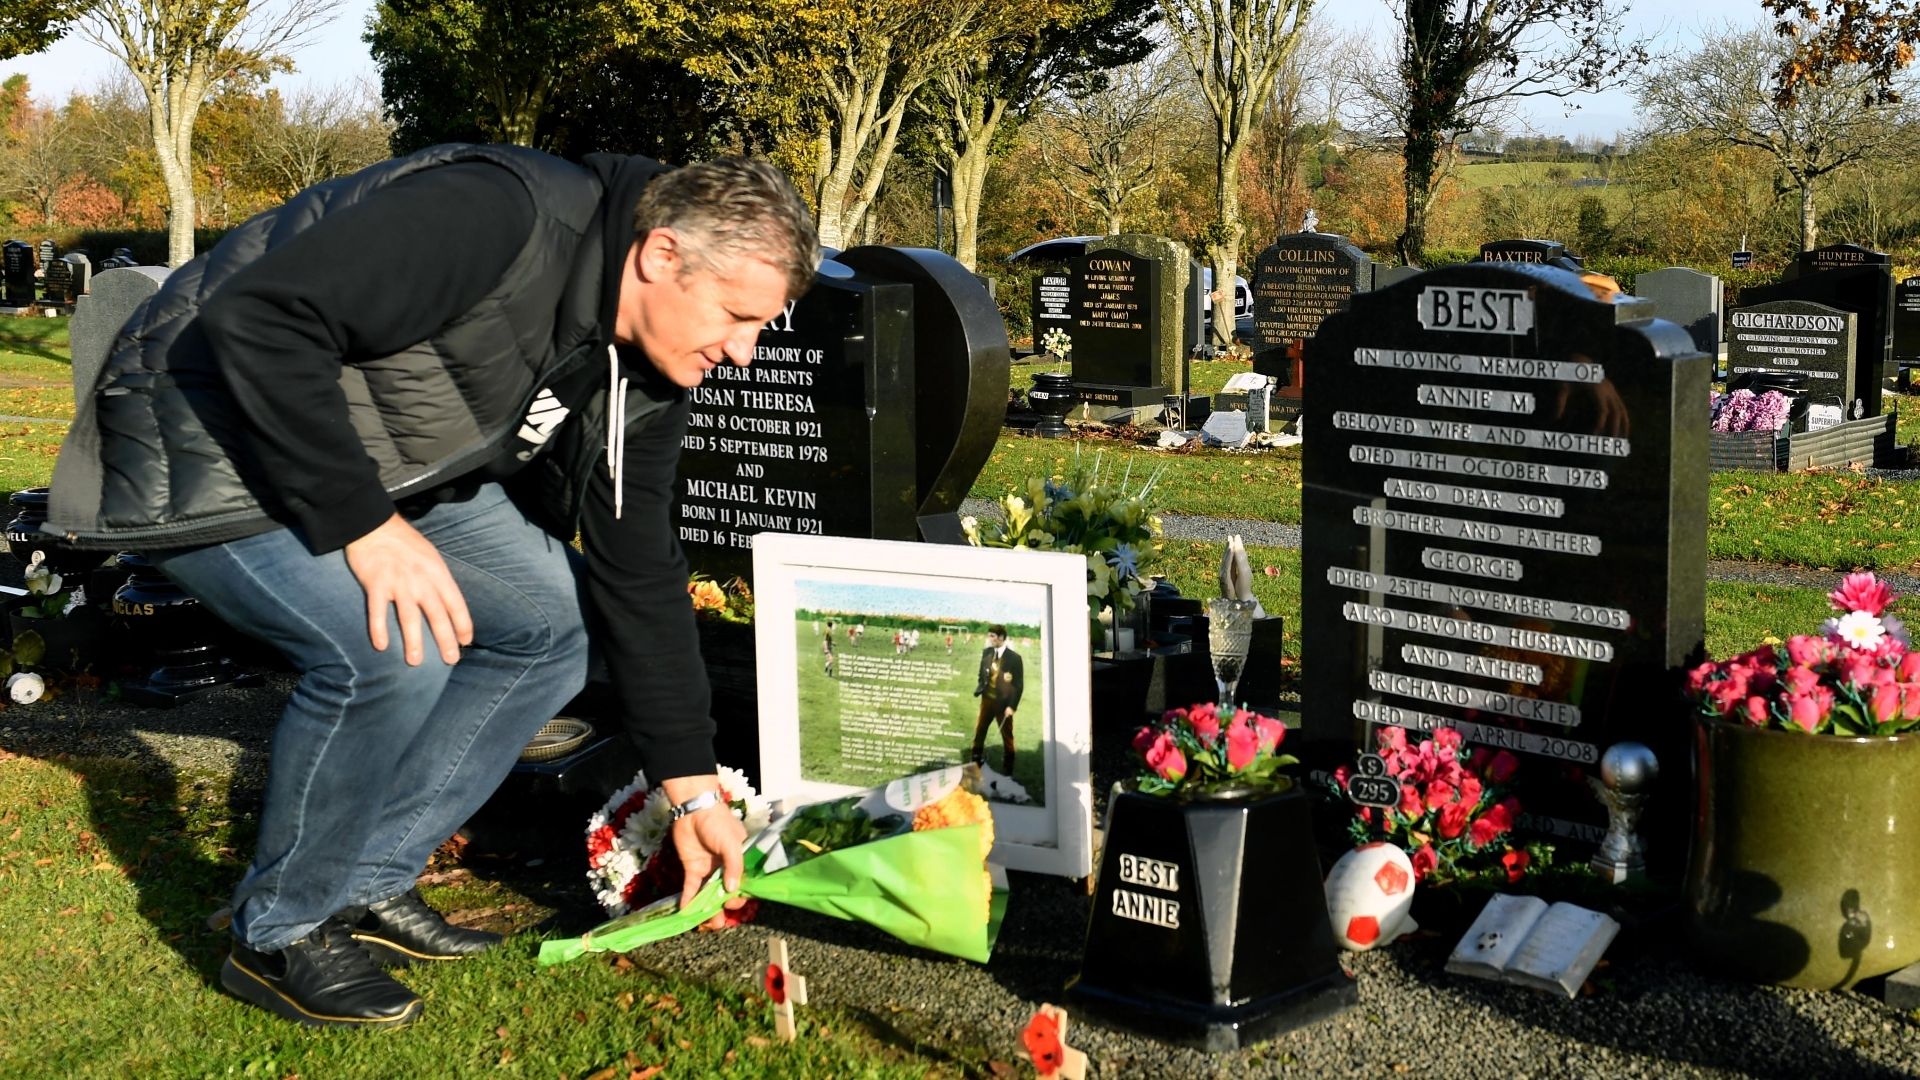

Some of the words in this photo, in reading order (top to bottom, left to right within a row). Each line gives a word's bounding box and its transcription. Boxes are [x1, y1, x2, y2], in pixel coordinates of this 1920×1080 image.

[1090, 260, 1130, 272] COWAN
[1279, 250, 1335, 262] COLLINS
[1484, 251, 1543, 264] BAXTER
[1818, 252, 1865, 262] HUNTER
[1274, 266, 1302, 274] LOVING
[1286, 314, 1324, 322] MAUREEN
[1432, 289, 1524, 331] BEST
[1737, 313, 1840, 330] RICHARDSON
[806, 348, 824, 364] OF
[1360, 350, 1377, 364] IN
[1393, 351, 1462, 372] LOVING
[1480, 358, 1560, 378] MEMORY
[1575, 364, 1600, 381] OF
[718, 366, 751, 381] DEAR
[756, 368, 813, 386] PARENTS
[740, 390, 815, 414] THERESA
[1426, 387, 1491, 409] ANNIE
[688, 412, 714, 428] ORN
[718, 414, 726, 429] 8
[730, 415, 791, 435] OCTOBER
[795, 421, 822, 438] 1921
[1338, 412, 1415, 434] BELOVED
[1429, 421, 1470, 440] WIFE
[1486, 427, 1526, 445] AND
[1542, 432, 1625, 456] MOTHER
[709, 436, 716, 451] 5
[720, 438, 794, 459] SEPTEMBER
[799, 445, 828, 463] 1978
[736, 463, 764, 478] AND
[1356, 446, 1394, 464] DIED
[1408, 450, 1448, 470] 12TH
[1462, 458, 1548, 482] OCTOBER
[1567, 468, 1605, 488] 1978
[687, 478, 758, 503] MICHAEL
[764, 488, 816, 510] KEVIN
[1392, 480, 1438, 500] ALSO
[1453, 488, 1501, 508] DEAR
[1518, 496, 1558, 514] SON
[682, 504, 716, 520] BORN
[720, 508, 730, 523] 11
[735, 510, 792, 530] JANUARY
[796, 518, 823, 534] 1921
[1361, 508, 1444, 534] BROTHER
[1460, 520, 1501, 542] AND
[1518, 527, 1592, 552] FATHER
[680, 526, 708, 543] DIED
[713, 530, 725, 545] 16
[1430, 552, 1516, 580] GEORGE
[1335, 569, 1377, 589] DIED
[1389, 578, 1432, 600] 25TH
[1450, 586, 1554, 618] NOVEMBER
[1570, 605, 1624, 628] 2005
[1349, 604, 1394, 626] ALSO
[1407, 612, 1495, 642] DEVOTED
[1508, 630, 1607, 660] HUSBAND
[1408, 646, 1450, 668] AND
[1464, 656, 1538, 682] FATHER
[1376, 672, 1471, 706] RICHARD
[1484, 690, 1578, 724] (DICKIE)
[1358, 702, 1402, 725] DIED
[1416, 712, 1457, 730] 16TH
[1473, 723, 1526, 750] APRIL
[1541, 737, 1593, 762] 2008
[1367, 758, 1377, 774] S
[1358, 781, 1390, 801] 295
[1124, 857, 1176, 886] BEST
[1116, 892, 1177, 926] ANNIE
